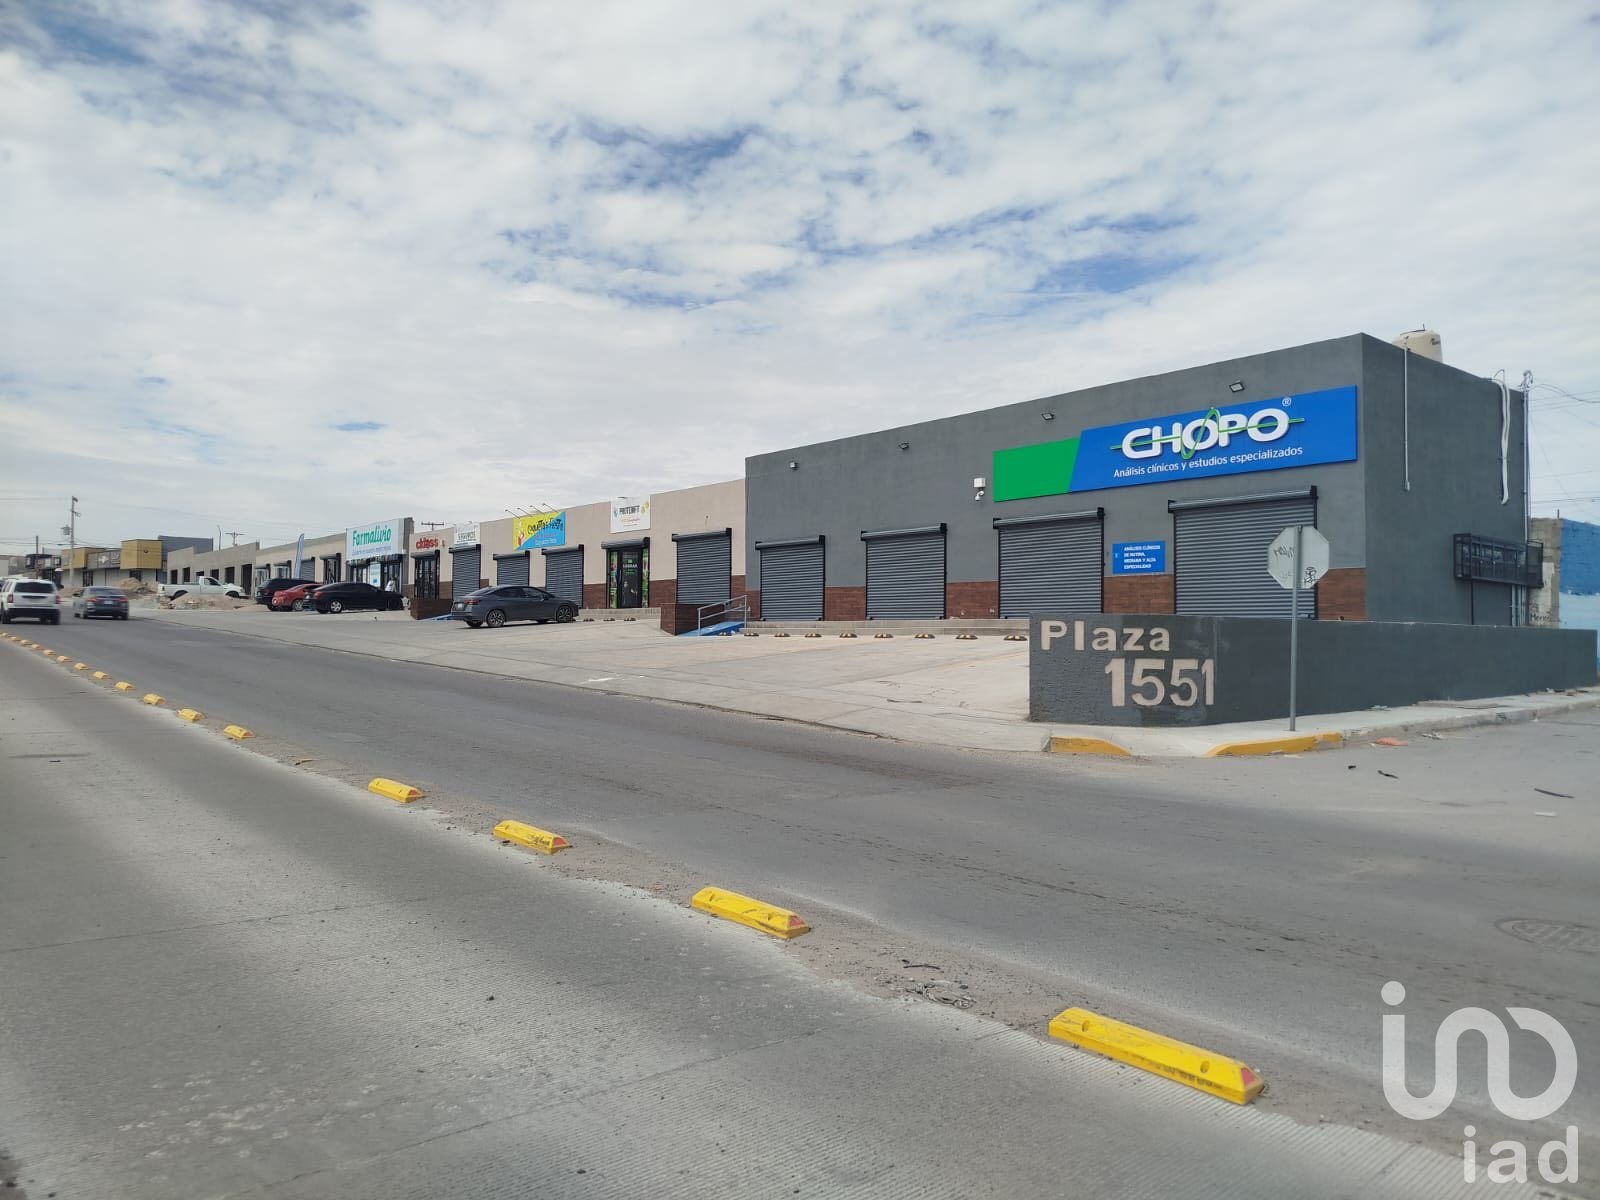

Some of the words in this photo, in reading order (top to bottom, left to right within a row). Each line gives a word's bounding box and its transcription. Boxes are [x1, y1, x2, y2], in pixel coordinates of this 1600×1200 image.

[1122, 408, 1289, 459] CHOPO
[1113, 466, 1145, 478] Análisis
[1147, 463, 1179, 474] clínicos
[1181, 462, 1188, 471] y
[1188, 455, 1228, 468] estudios
[1230, 446, 1304, 463] especializados
[1041, 620, 1170, 651] Plaza
[1104, 658, 1214, 707] 1551
